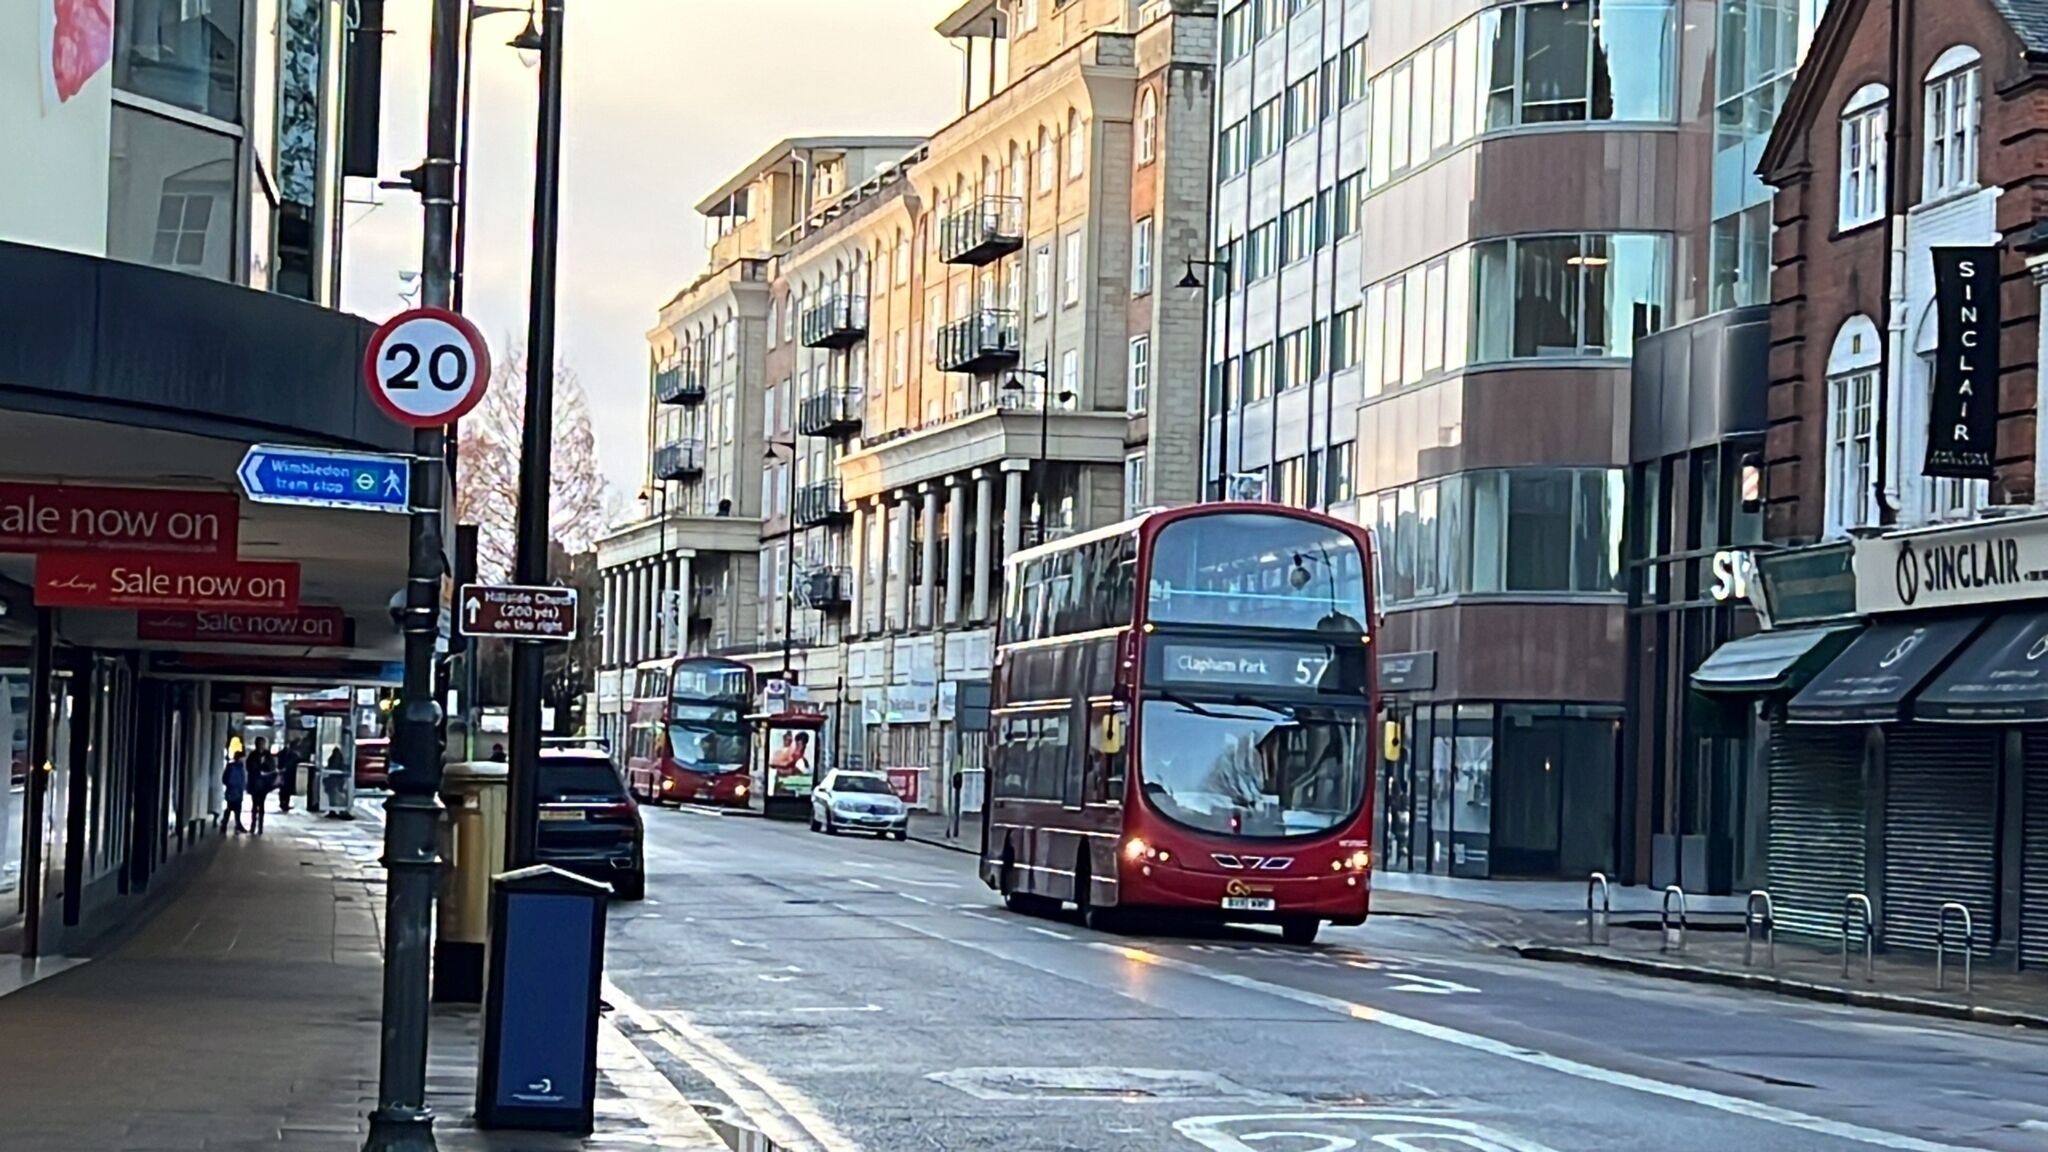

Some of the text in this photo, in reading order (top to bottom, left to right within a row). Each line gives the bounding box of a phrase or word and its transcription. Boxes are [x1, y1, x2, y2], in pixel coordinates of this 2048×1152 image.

[1954, 261, 1977, 441] SINCLAIR
[386, 343, 467, 391] 20
[271, 459, 350, 478] Wimbledon
[276, 477, 344, 493] tram stop
[0, 495, 218, 540] ale now on
[1924, 538, 2020, 592] SINCLAIR
[110, 566, 170, 595] Sale
[177, 575, 242, 597] now
[248, 577, 286, 598] on
[485, 591, 531, 604] Hillside
[500, 604, 532, 617] (200
[197, 610, 245, 633] Sale
[248, 614, 298, 634] now
[302, 617, 332, 635] on
[514, 620, 534, 631] the
[1178, 655, 1330, 686] Clapham Park 57
